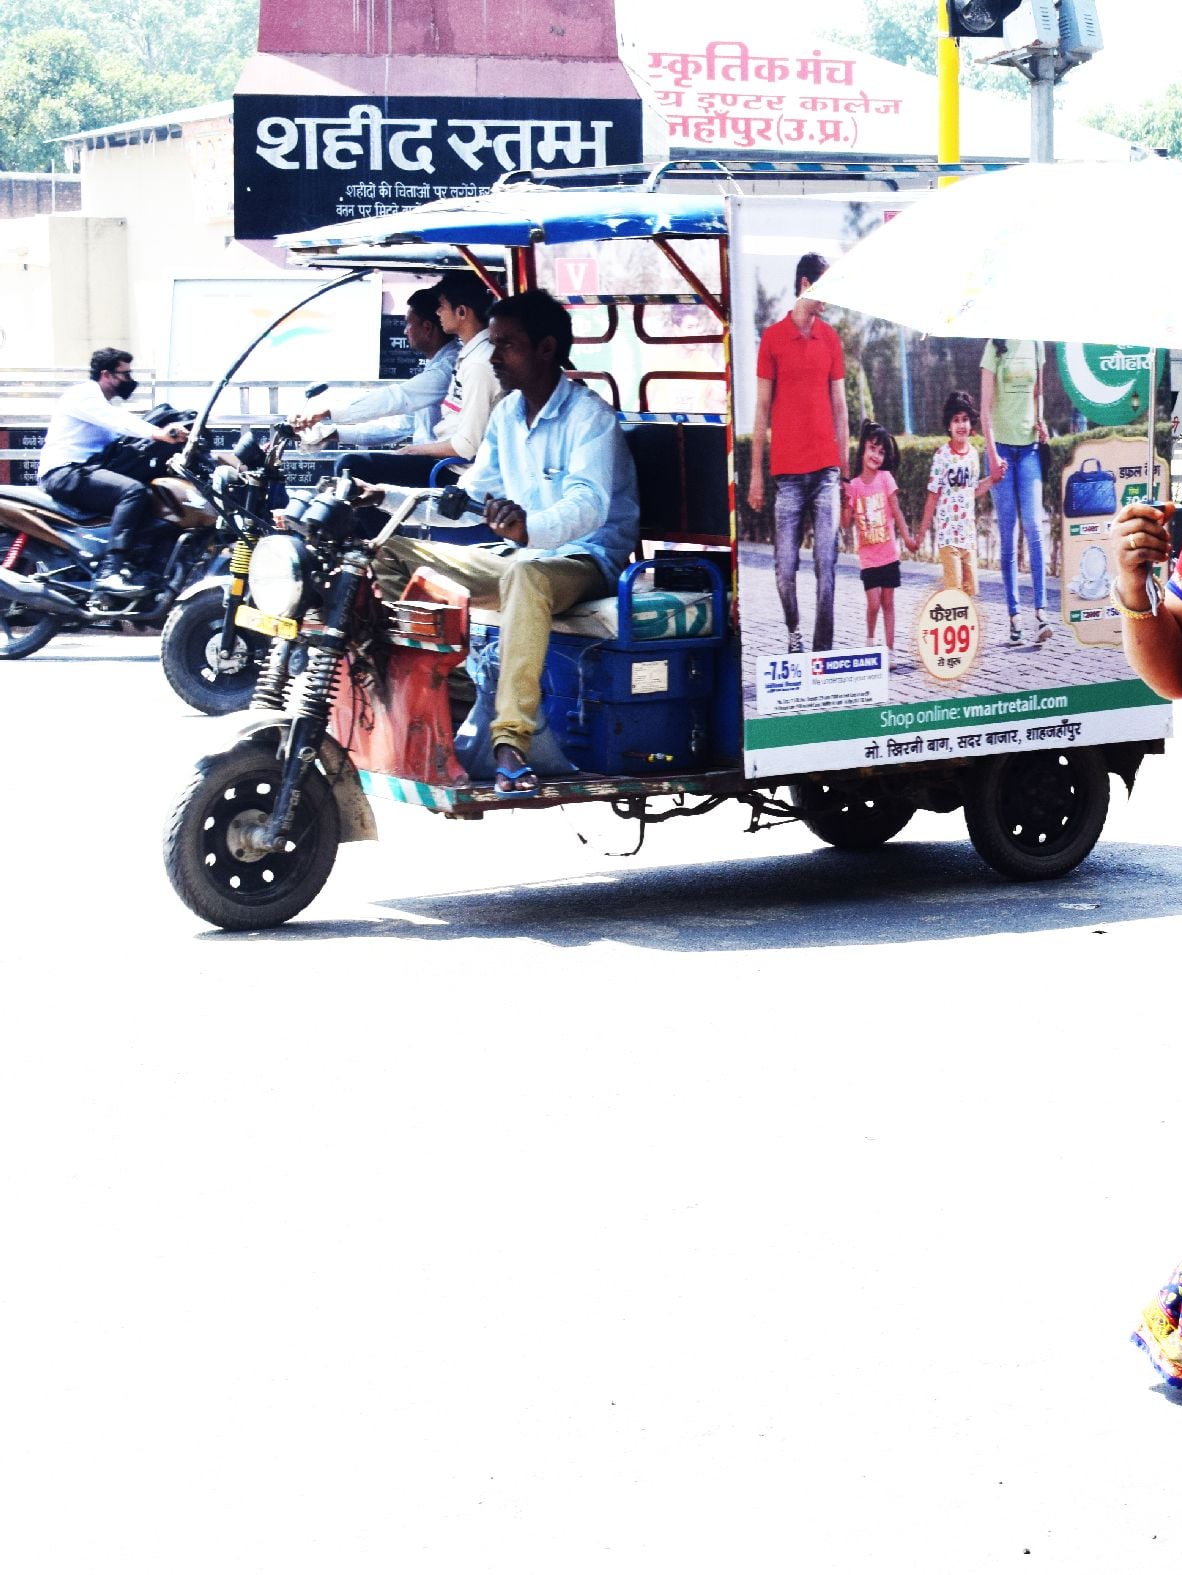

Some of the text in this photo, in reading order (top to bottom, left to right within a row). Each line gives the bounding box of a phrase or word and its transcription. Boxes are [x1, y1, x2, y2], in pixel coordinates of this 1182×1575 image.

[796, 50, 857, 86] मंच
[697, 92, 786, 114] इण्टर
[799, 89, 903, 114] कालेज
[256, 104, 613, 173] शहीद स्तम्भ
[379, 181, 392, 198] की
[395, 182, 430, 199] चिताओं
[433, 186, 448, 200] पर
[336, 204, 355, 217] वतन
[358, 205, 371, 217] पर
[929, 604, 969, 622] फैशन
[826, 657, 879, 670] HDFC BANK
[880, 695, 1068, 728] Shop online: vmartretail.com
[887, 736, 923, 757] खिरनी
[927, 737, 953, 752] बाग,
[957, 734, 982, 748] सदर
[985, 730, 1022, 745] बाजार,
[1026, 719, 1081, 741] शाहजहाँपुर
